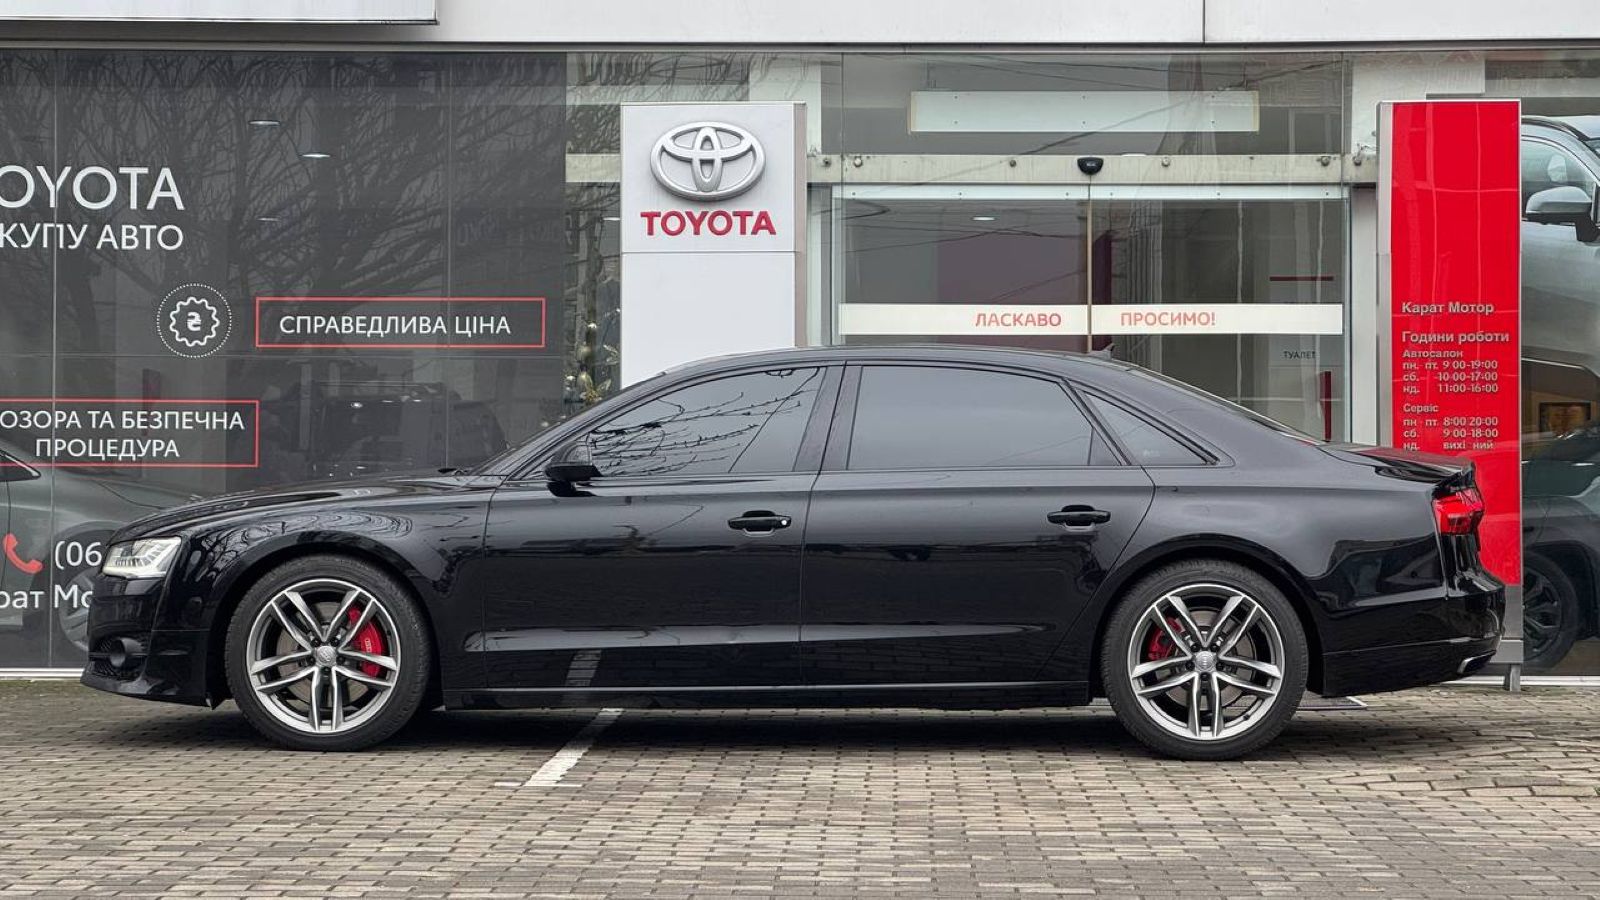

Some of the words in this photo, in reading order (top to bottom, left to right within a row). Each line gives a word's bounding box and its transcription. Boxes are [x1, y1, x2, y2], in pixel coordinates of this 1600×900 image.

[0, 165, 185, 210] OYOTA
[640, 210, 776, 236] TOYOTA
[96, 223, 184, 250] АВТО
[1401, 302, 1445, 316] Карат
[1448, 301, 1495, 316] Мотор
[279, 315, 447, 337] СПРАВЕДЛИВА
[455, 315, 511, 338] ЦІНА
[975, 312, 1062, 327] ЛАСКАВО
[1120, 311, 1217, 327] ПРОСИМО!
[1401, 330, 1454, 345] Години
[1458, 330, 1510, 345] роботи
[1283, 350, 1316, 360] ТУАЛЕТ
[1402, 349, 1464, 358] Автосалон
[1403, 402, 1440, 414] Сервіс
[0, 410, 82, 429] ОЗОРА
[88, 411, 115, 429] ТА
[121, 411, 245, 430] БЕЗПЕЧНА
[35, 439, 180, 461] ПРОЦЕДУРА
[55, 540, 102, 570] (06
